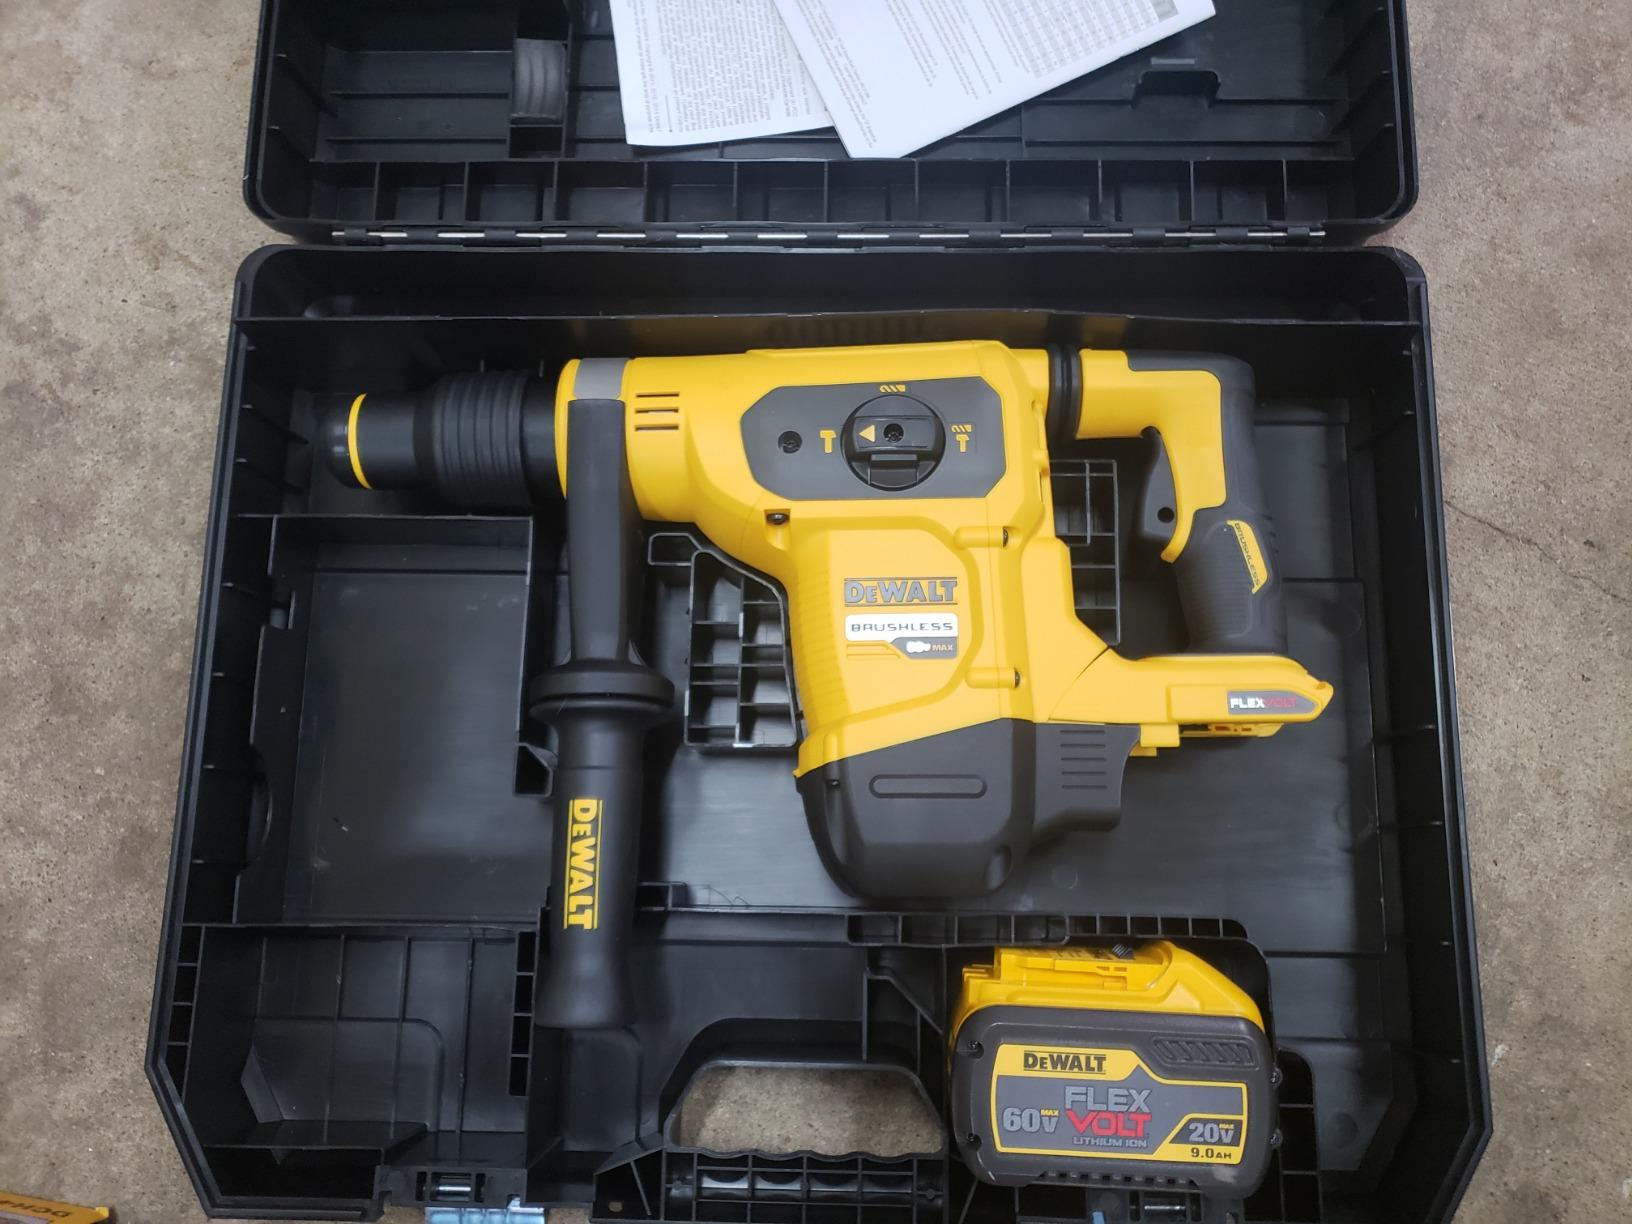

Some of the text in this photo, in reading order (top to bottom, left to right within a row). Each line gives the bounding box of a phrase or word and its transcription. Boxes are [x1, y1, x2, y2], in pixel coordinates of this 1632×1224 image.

[851, 622, 953, 632] BRUSHLESS
[1065, 1086, 1150, 1112] FLEX
[1003, 1107, 1058, 1133] 60V
[1066, 1111, 1151, 1137] VOLT
[1074, 1136, 1147, 1147] LITHIUM ION
[1189, 1122, 1234, 1143] 20V
